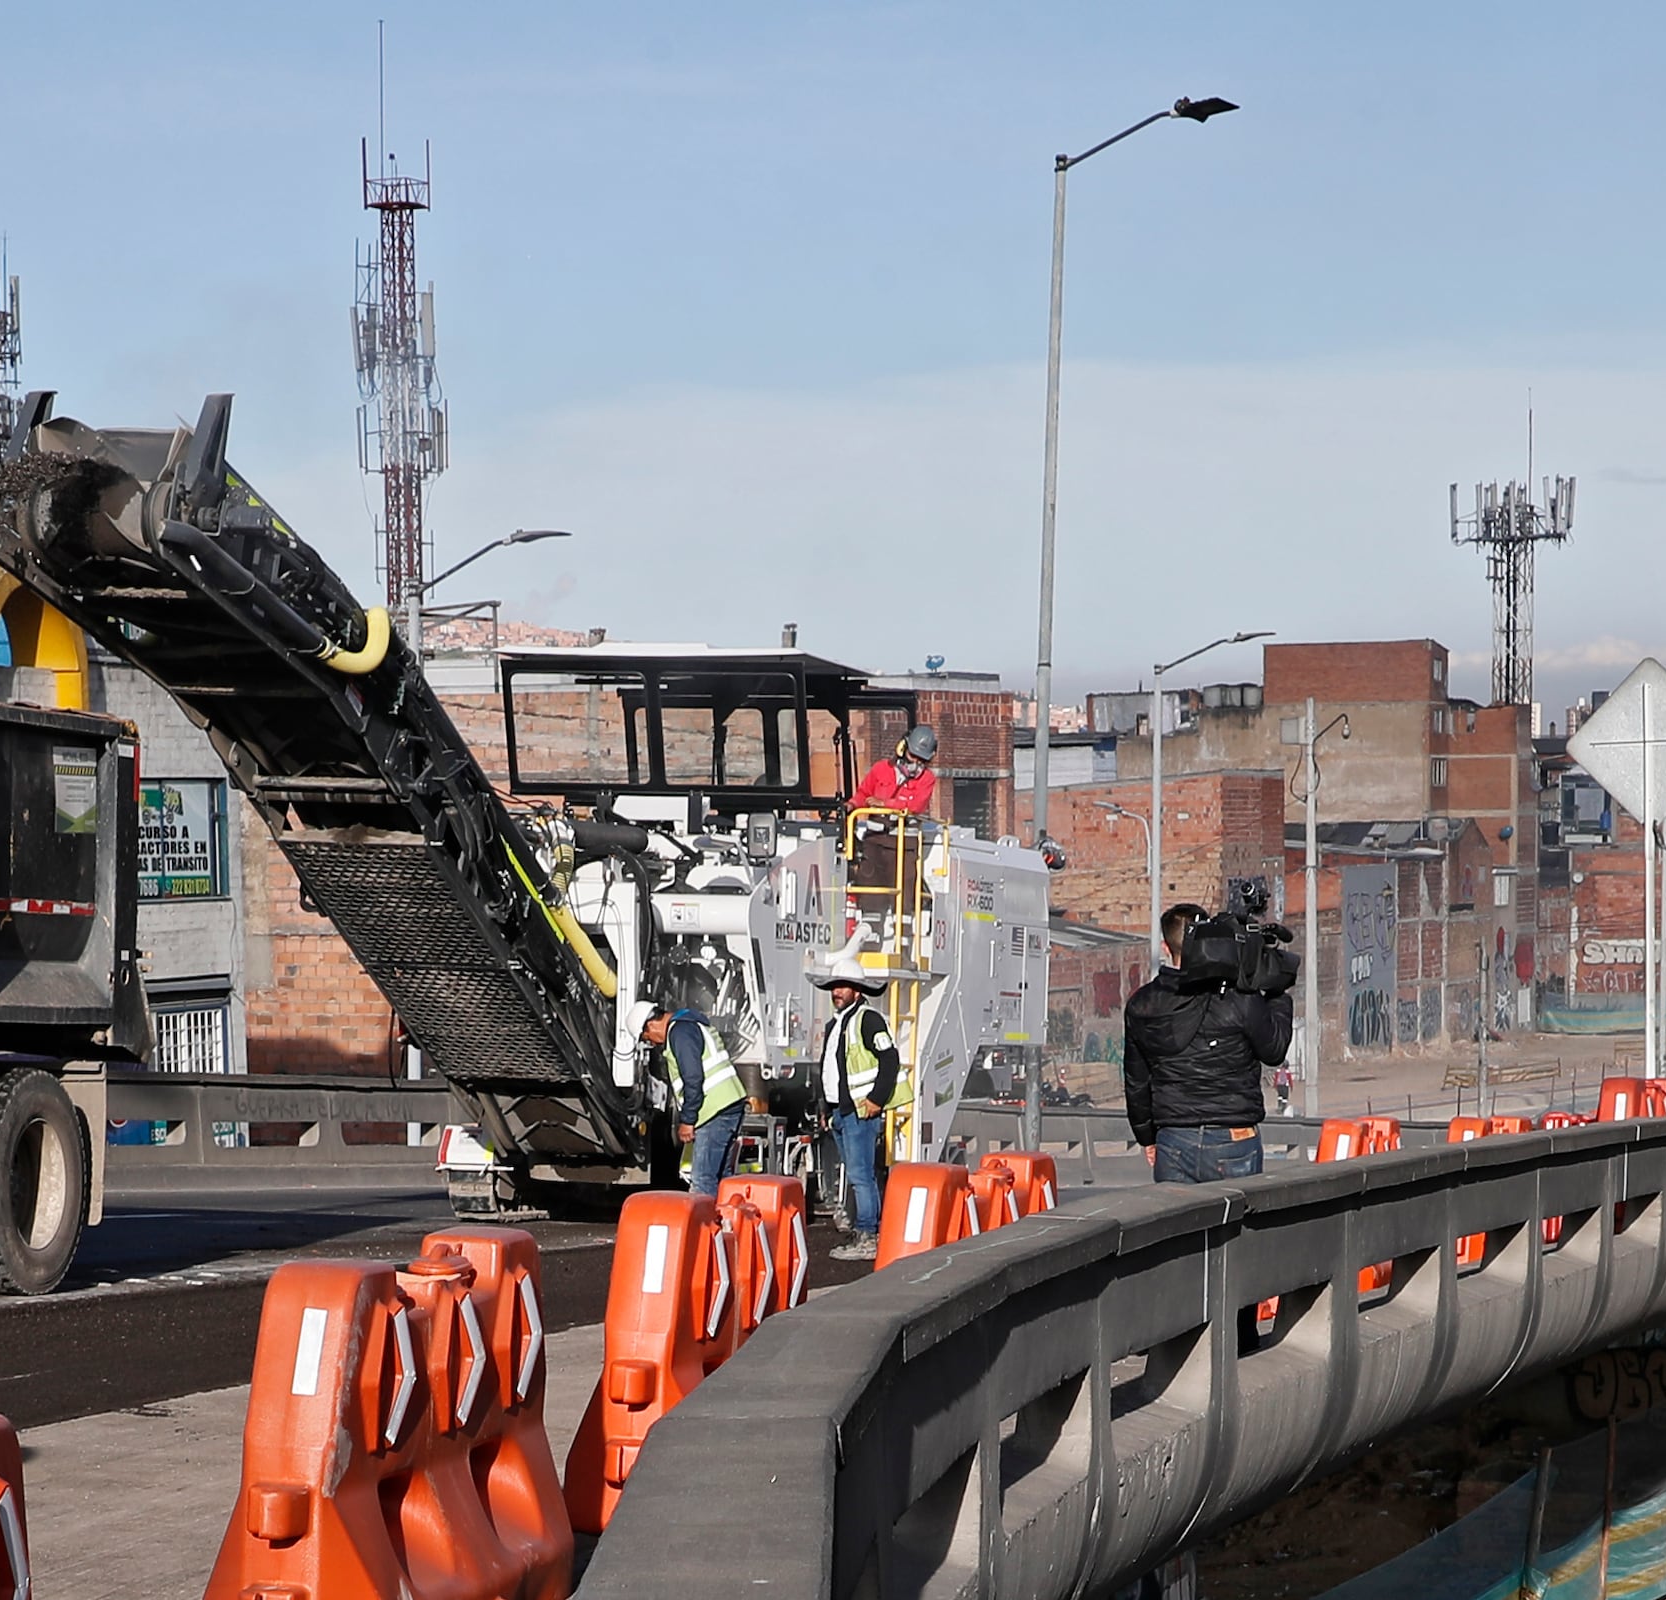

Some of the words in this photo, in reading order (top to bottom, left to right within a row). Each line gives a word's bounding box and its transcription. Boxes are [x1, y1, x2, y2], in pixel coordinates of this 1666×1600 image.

[138, 826, 177, 839] CURSO
[182, 826, 189, 838] A
[194, 841, 206, 854] EN
[166, 857, 208, 872] TRANSITO
[795, 922, 831, 945] ASTEC
